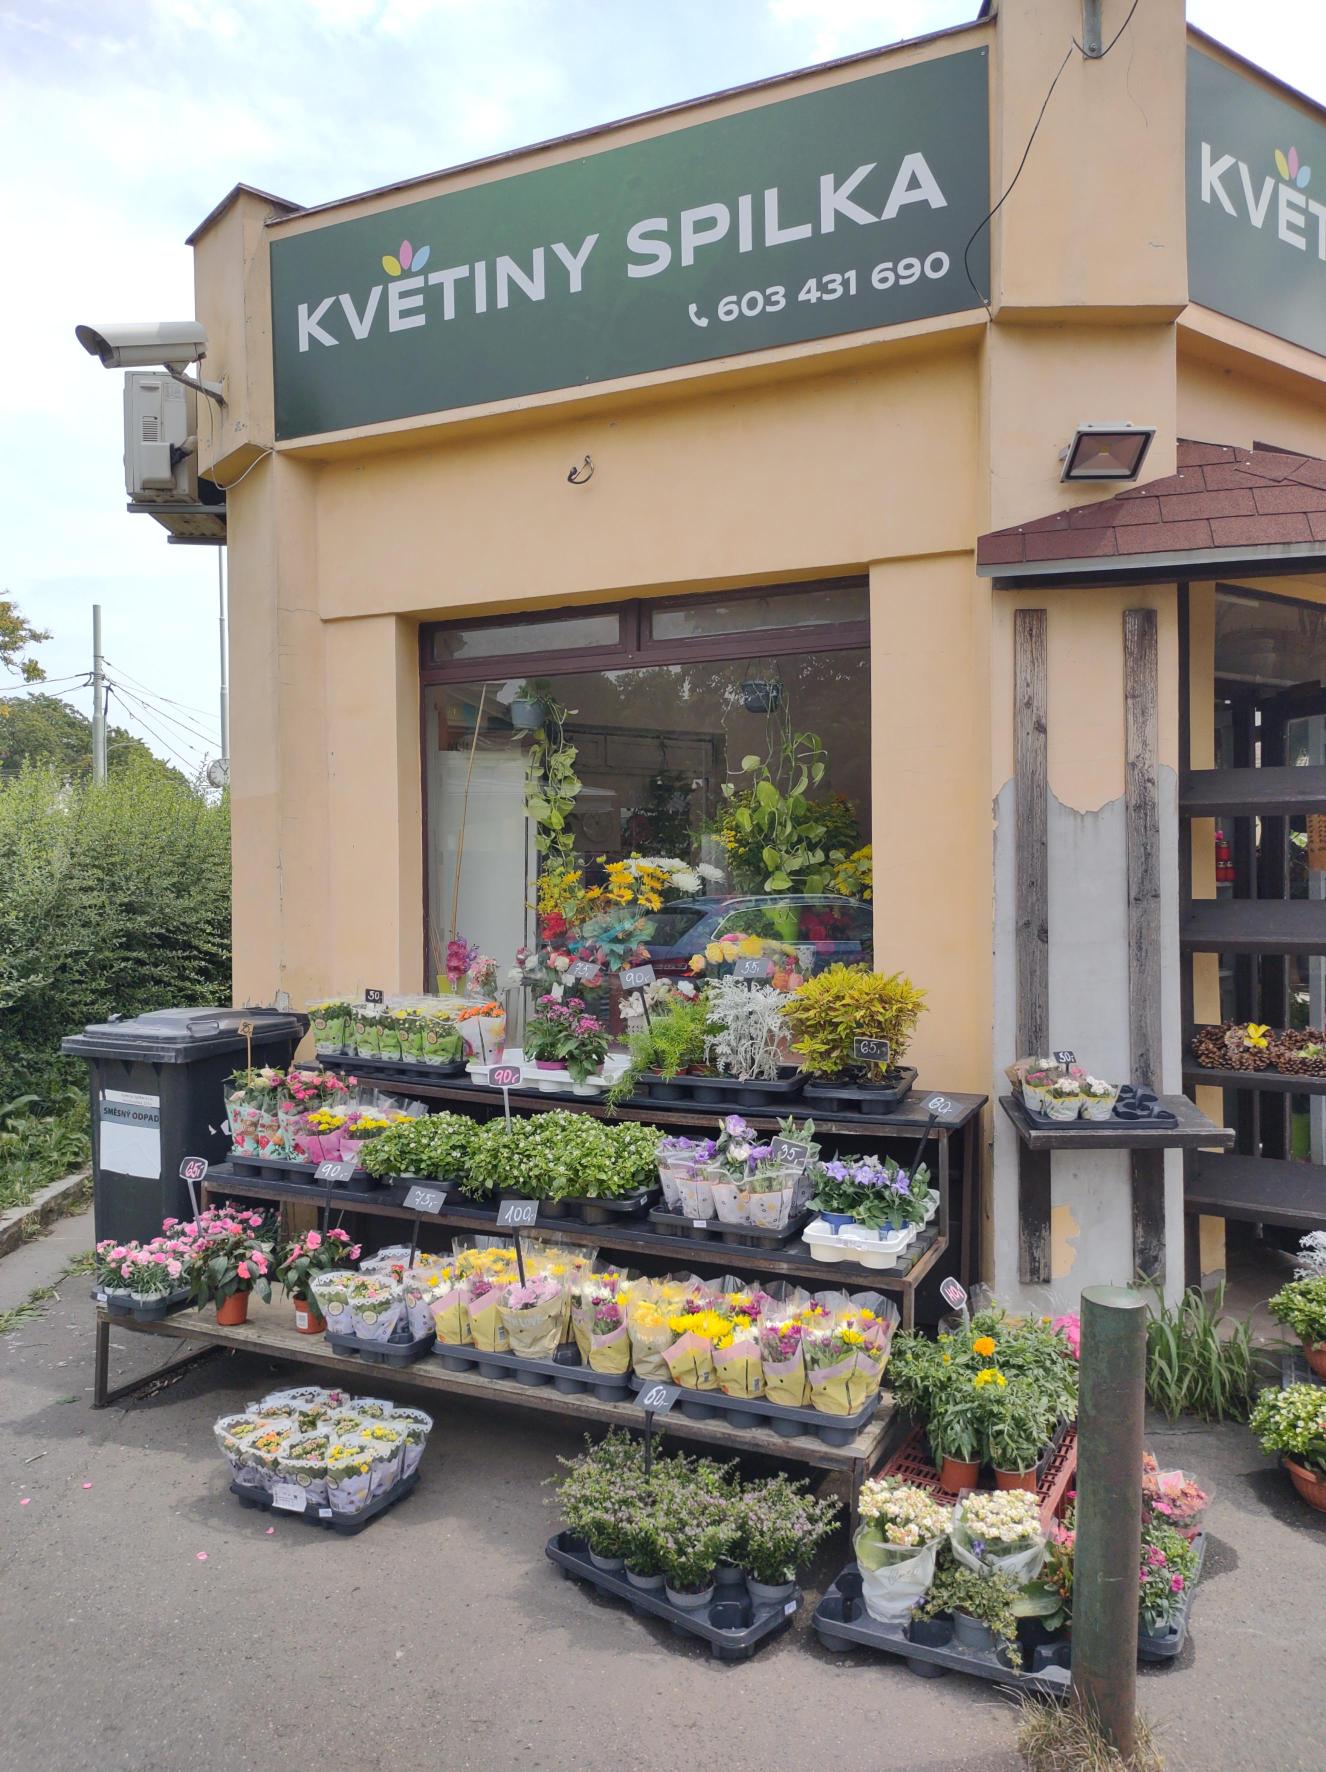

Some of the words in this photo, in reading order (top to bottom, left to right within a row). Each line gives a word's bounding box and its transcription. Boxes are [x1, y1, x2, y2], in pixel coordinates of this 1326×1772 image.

[627, 152, 948, 278] SPILKA
[717, 286, 786, 322] 603
[798, 269, 857, 303] 431
[871, 251, 950, 290] 690
[131, 1111, 159, 1123] ODPAD
